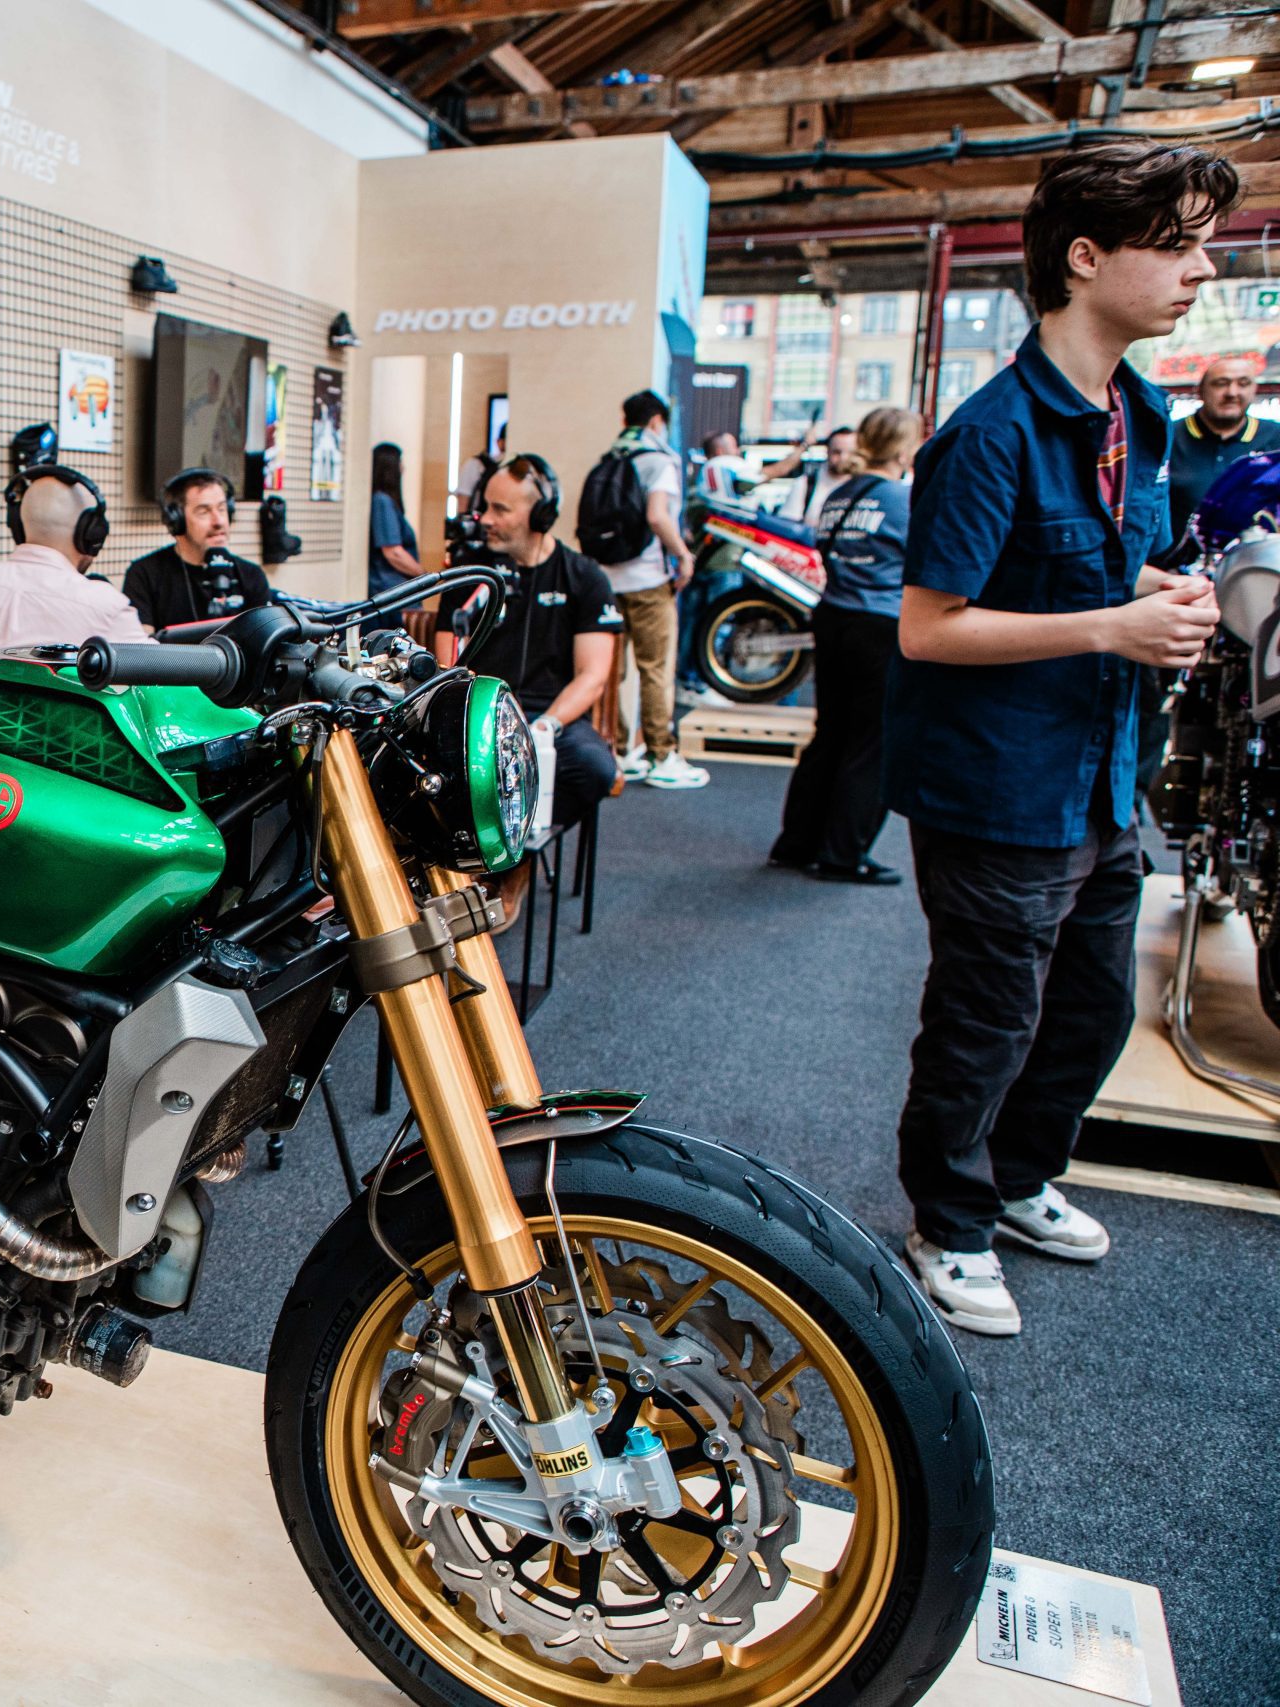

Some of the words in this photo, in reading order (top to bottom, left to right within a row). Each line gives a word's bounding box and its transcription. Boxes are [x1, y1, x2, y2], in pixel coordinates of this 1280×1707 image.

[0, 139, 59, 185] TYRES
[67, 139, 81, 167] &
[374, 306, 497, 334] PHOTO
[502, 301, 637, 331] BOOTH
[312, 1299, 356, 1387] MICHELIN
[388, 1392, 426, 1457] brembo
[996, 1588, 1011, 1643] MICHELIN
[1025, 1606, 1039, 1643] POWER
[1046, 1600, 1060, 1609] 7
[1046, 1610, 1063, 1650] SUPER
